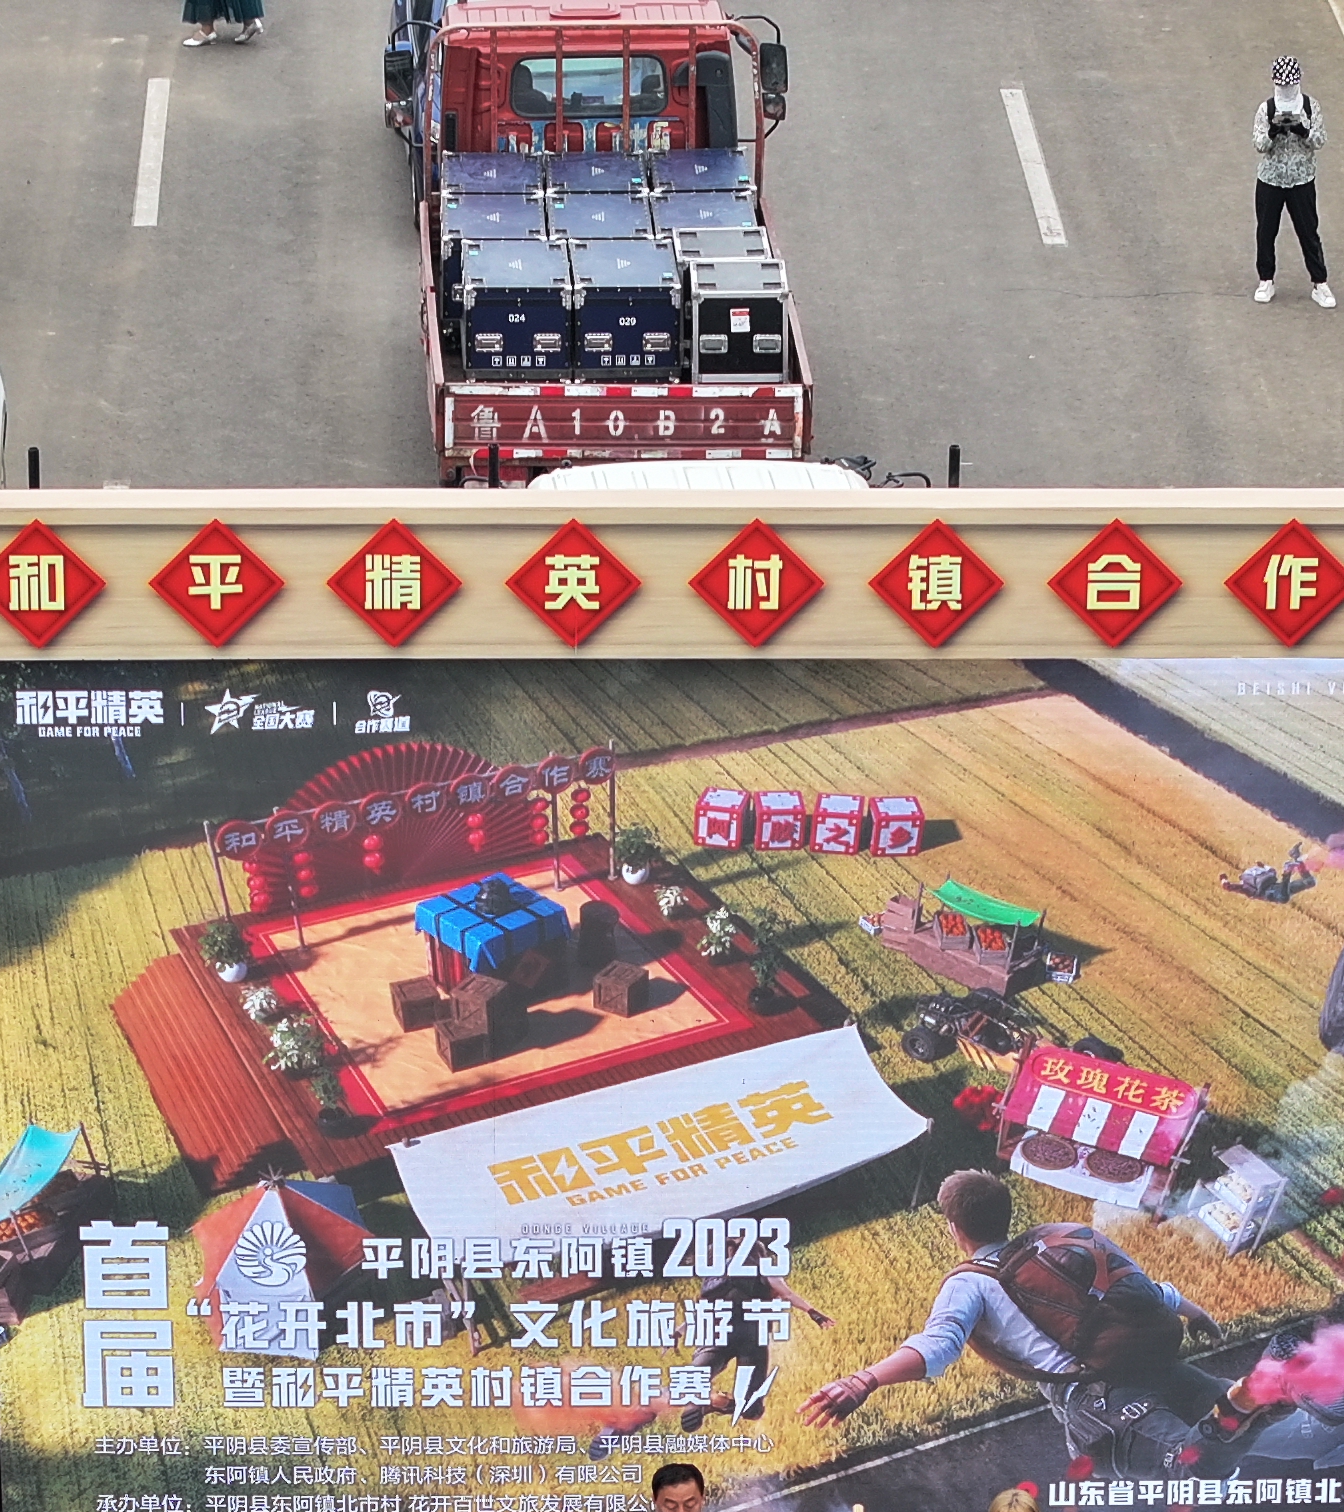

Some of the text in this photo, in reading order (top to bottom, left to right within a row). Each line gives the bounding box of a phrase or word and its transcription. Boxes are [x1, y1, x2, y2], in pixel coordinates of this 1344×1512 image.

[15, 690, 164, 724] 和平精英
[1237, 681, 1312, 696] BEISHI
[38, 726, 141, 737] GAME FOR PEACE
[252, 709, 315, 730] 全国大赛
[354, 715, 412, 734] 合作赛道
[1040, 1056, 1186, 1114] 玫瑰花茶
[487, 1080, 834, 1206] 和平精英
[566, 1136, 799, 1208] GAME FOR PEACE
[361, 1217, 791, 1280] 平阴县东阿镇 2023
[78, 1220, 174, 1409] 首届
[509, 1299, 791, 1350] 文化旅游节
[222, 1364, 713, 1410] 暨和平精英村镇合作赛
